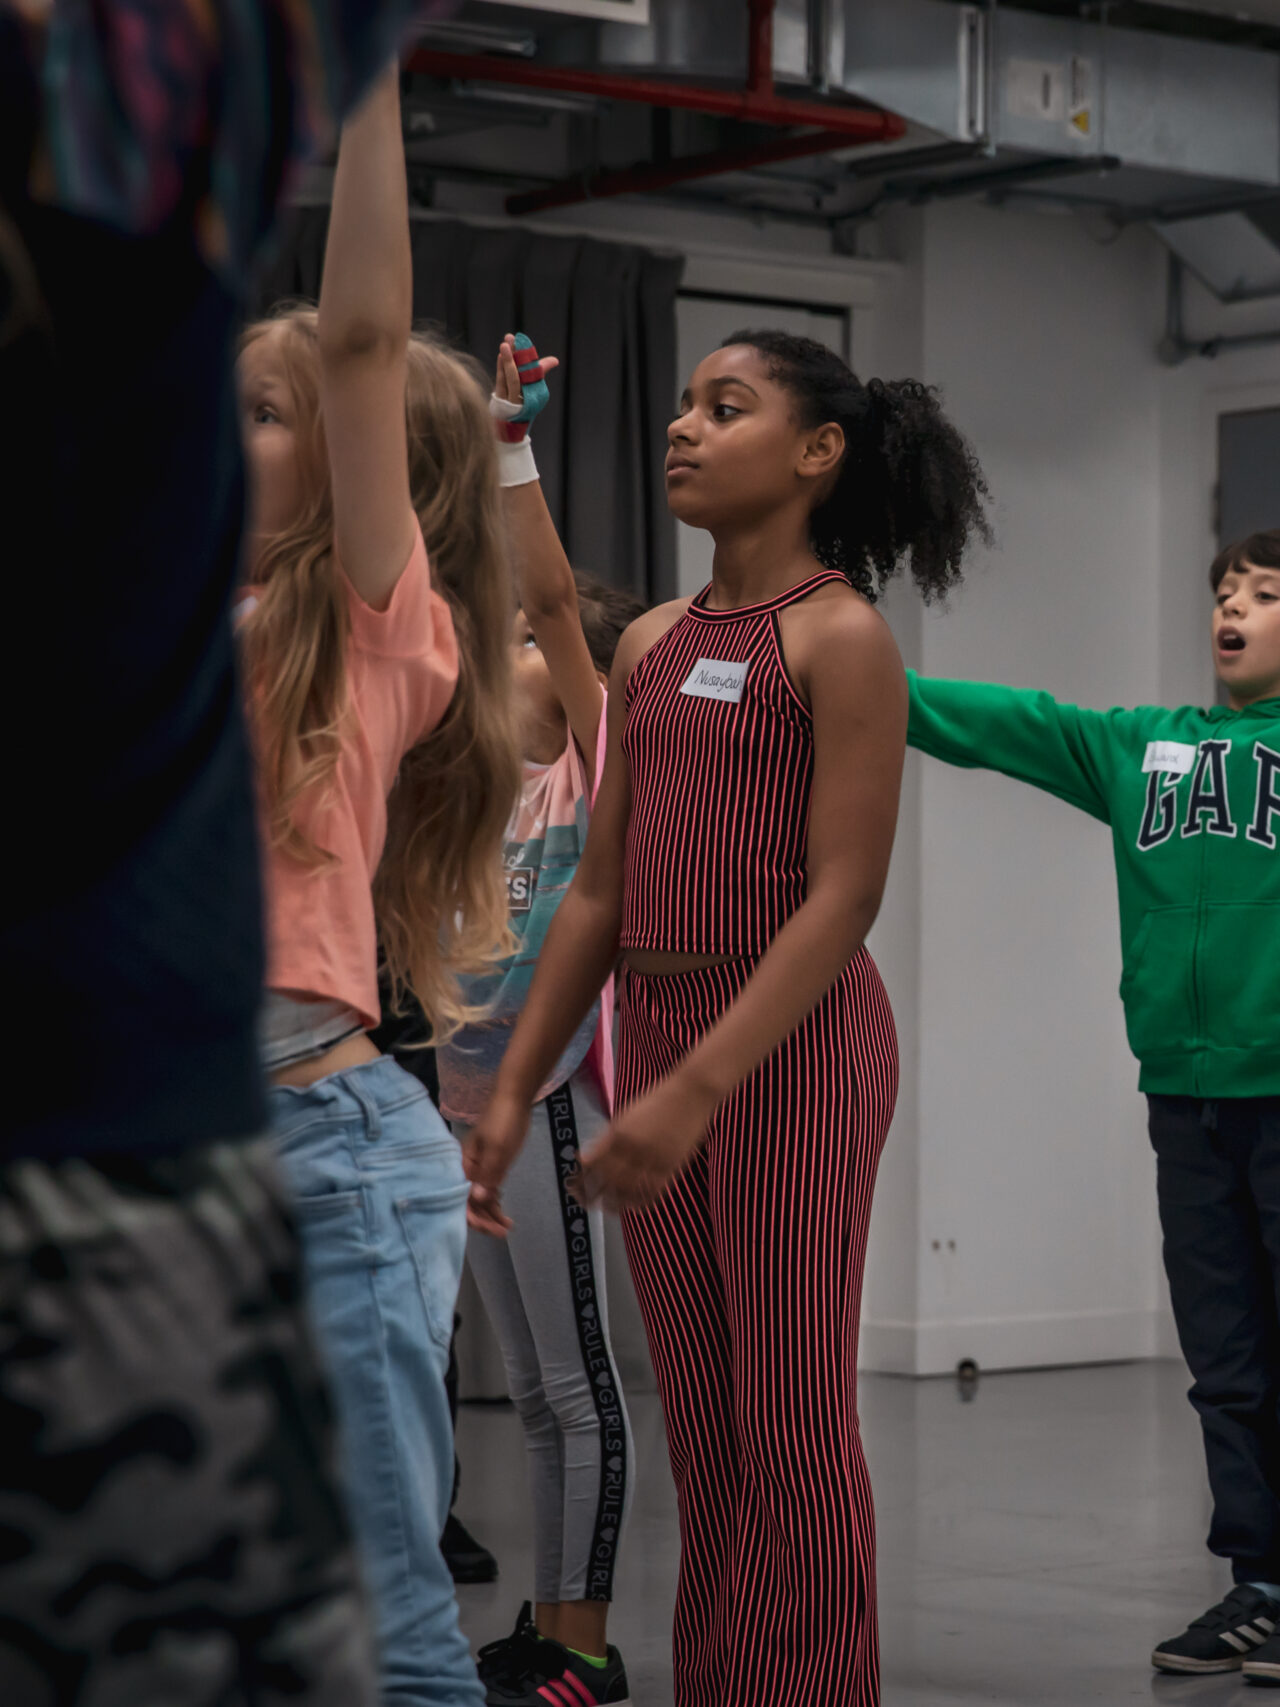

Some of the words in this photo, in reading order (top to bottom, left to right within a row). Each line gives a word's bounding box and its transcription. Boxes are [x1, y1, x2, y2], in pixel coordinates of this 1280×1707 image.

[551, 1091, 573, 1141] IRLS
[571, 1237, 593, 1301] GIRLS
[581, 1321, 607, 1372] RULE
[598, 1388, 622, 1452] GIRLS
[601, 1472, 622, 1525] RULE
